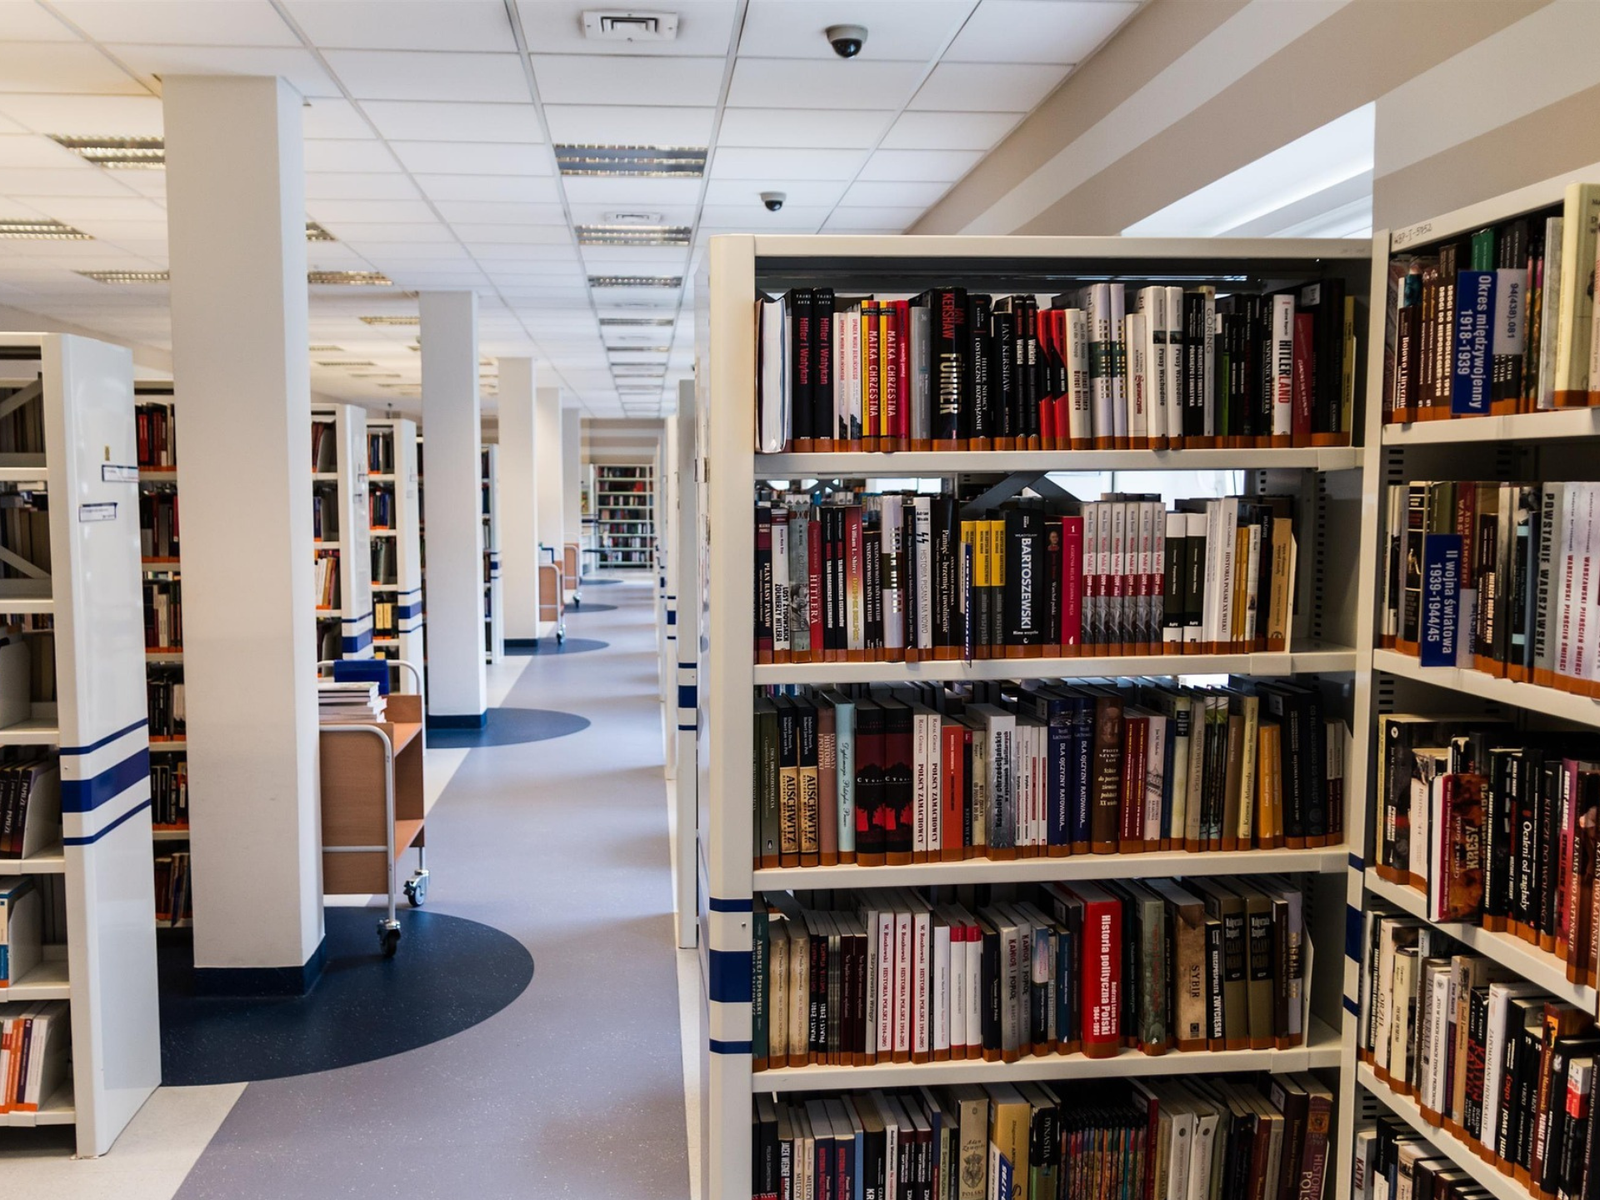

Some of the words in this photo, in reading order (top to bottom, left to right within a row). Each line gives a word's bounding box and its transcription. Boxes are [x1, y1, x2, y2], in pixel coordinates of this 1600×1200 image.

[1477, 275, 1492, 311] Okres
[1507, 283, 1519, 339] 94(438).081
[942, 293, 954, 338] KERSHAW
[869, 330, 878, 359] MATKA
[888, 330, 896, 359] MATKA
[1457, 309, 1473, 375] 1918-1939
[1469, 314, 1489, 408] międzywojenny
[798, 348, 809, 384] Watykan
[819, 348, 829, 384] Watykan
[940, 353, 965, 414] FÜHRER
[1278, 340, 1292, 403] HITLERLAND
[869, 365, 878, 416] CHRZESTNA
[888, 365, 896, 416] CHRZESTNA
[941, 530, 949, 554] Pamięć
[1541, 493, 1554, 563] POWSTANIE
[1446, 550, 1458, 558] II
[941, 562, 950, 589] brzemię
[1021, 538, 1031, 629] BARTOSZEWSKI
[1442, 561, 1456, 596] wojna
[1565, 555, 1574, 601] WARSZAWSKI
[1580, 556, 1590, 604] WARSZAWSKI
[810, 574, 818, 624] HITLERA
[922, 605, 927, 613] NA
[942, 595, 950, 632] uwolnienie
[1427, 563, 1442, 642] 1939-1944/45
[1536, 569, 1549, 658] WARSZAWSKIE
[1442, 599, 1458, 654] światowa
[1562, 604, 1571, 640] PIERŚCIEŃ
[1578, 606, 1587, 644] PIERŚCIEŃ
[1560, 642, 1568, 671] ŚMIERCI
[1575, 645, 1585, 676] ŚMIERCI
[994, 731, 1003, 792] chrześcijańskie
[786, 775, 796, 843] AUSCHWITZ
[806, 775, 816, 843] AUSCHWITZ
[995, 795, 1003, 828] Kościoły
[1466, 826, 1479, 869] KRESY
[1522, 821, 1532, 858] Ocaleni
[1542, 844, 1550, 862] DO
[1522, 860, 1529, 871] od
[1571, 836, 1580, 894] KŁAMSTWO
[1520, 874, 1529, 911] zagłady
[1540, 866, 1549, 926] WOLNOŚCI
[1101, 915, 1111, 953] Historia
[1568, 895, 1578, 952] KATYŃSKIE
[1591, 902, 1599, 959] KATYŃSKIE
[1100, 955, 1111, 1004] polityczna
[1192, 965, 1200, 998] SYBIR
[1101, 1006, 1110, 1035] Polski
[1212, 995, 1222, 1037] ZWYCIĘSKA
[1485, 1028, 1494, 1082] ZAPOMNIANY
[1544, 1050, 1552, 1074] Damian
[1504, 1074, 1512, 1100] obcy
[1540, 1075, 1550, 1111] Markowski
[1482, 1084, 1492, 1131] HOLOKAUST
[781, 1143, 790, 1156] JACEK
[1043, 1118, 1051, 1158] DYNASTIA
[781, 1157, 790, 1177] WEGNER
